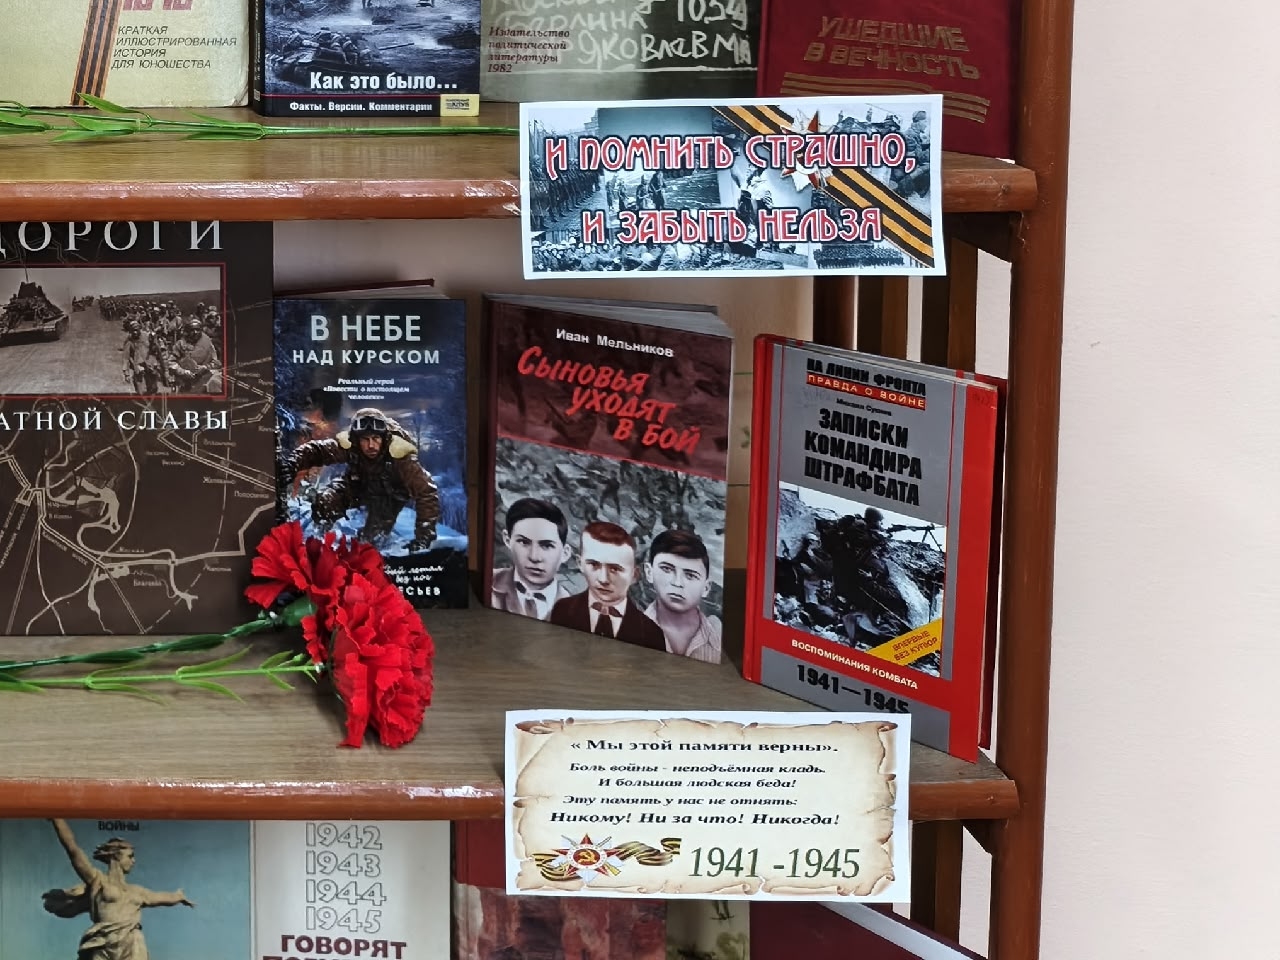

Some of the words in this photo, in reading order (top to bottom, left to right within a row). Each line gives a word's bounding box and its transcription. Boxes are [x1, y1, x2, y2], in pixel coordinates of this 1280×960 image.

[115, 36, 238, 47] ИЛЛЮСТРИРОВАННАЯ
[117, 25, 169, 35] КРАТКАЯ
[488, 25, 570, 39] Издательство
[819, 15, 970, 53] УШЕДШИЕ
[110, 59, 135, 70] ДЛЯ
[139, 59, 211, 69] ЮНОШЕСТВА
[113, 48, 167, 58] ИСТОРИЯ
[829, 44, 980, 81] ВЕЧНОСТЬ
[487, 62, 513, 73] 1982
[310, 71, 344, 90] Как
[350, 75, 380, 90] это
[386, 71, 458, 90] было...
[289, 101, 326, 112] Факты.
[328, 101, 366, 112] Версии.
[368, 101, 433, 112] Комментарии
[545, 138, 568, 180] И
[578, 134, 735, 171] ПОМНИТЬ
[745, 132, 917, 175] СТРАШНО,
[582, 210, 605, 244] И
[618, 207, 748, 243] ЗАБЫТЬ
[759, 207, 883, 242] НЕЛЬЗЯ
[310, 315, 330, 341] В
[342, 315, 421, 342] НЕБЕ
[556, 328, 590, 344] Иван
[596, 334, 675, 358] Мельников
[292, 349, 334, 366] НАД
[342, 349, 440, 365] КУРСКОМ
[117, 408, 229, 431] СЛАВЫ
[819, 407, 909, 449] ЗАПИСКИ
[804, 430, 923, 481] КОМАНДИРА
[804, 455, 921, 507] ШТРАФБАТА
[791, 639, 871, 673] ВОСПОМИНАНИЯ
[871, 667, 919, 690] КОМБАТА
[586, 739, 623, 751] Мы
[627, 739, 673, 752] этой
[678, 740, 754, 752] памяти
[758, 741, 839, 754] верны».
[569, 761, 607, 773] Боль
[610, 762, 659, 773] войны
[672, 762, 775, 775] неподъёмная
[778, 764, 827, 775] кладь.
[615, 777, 683, 789] большая
[686, 777, 753, 789] людская
[756, 776, 797, 789] беда!
[562, 795, 598, 807] Эту
[600, 795, 662, 807] память
[676, 797, 705, 807] нас
[708, 797, 726, 807] не
[729, 797, 798, 808] отнять:
[550, 811, 632, 827] Никому!
[671, 813, 693, 826] за
[751, 811, 840, 827] Никогда!
[305, 822, 383, 852] 1942
[305, 850, 382, 879] 1943
[688, 846, 760, 880] 1941
[305, 878, 388, 907] 1944
[305, 906, 382, 934] 1945
[280, 934, 408, 959] ГОВОРЯТ
